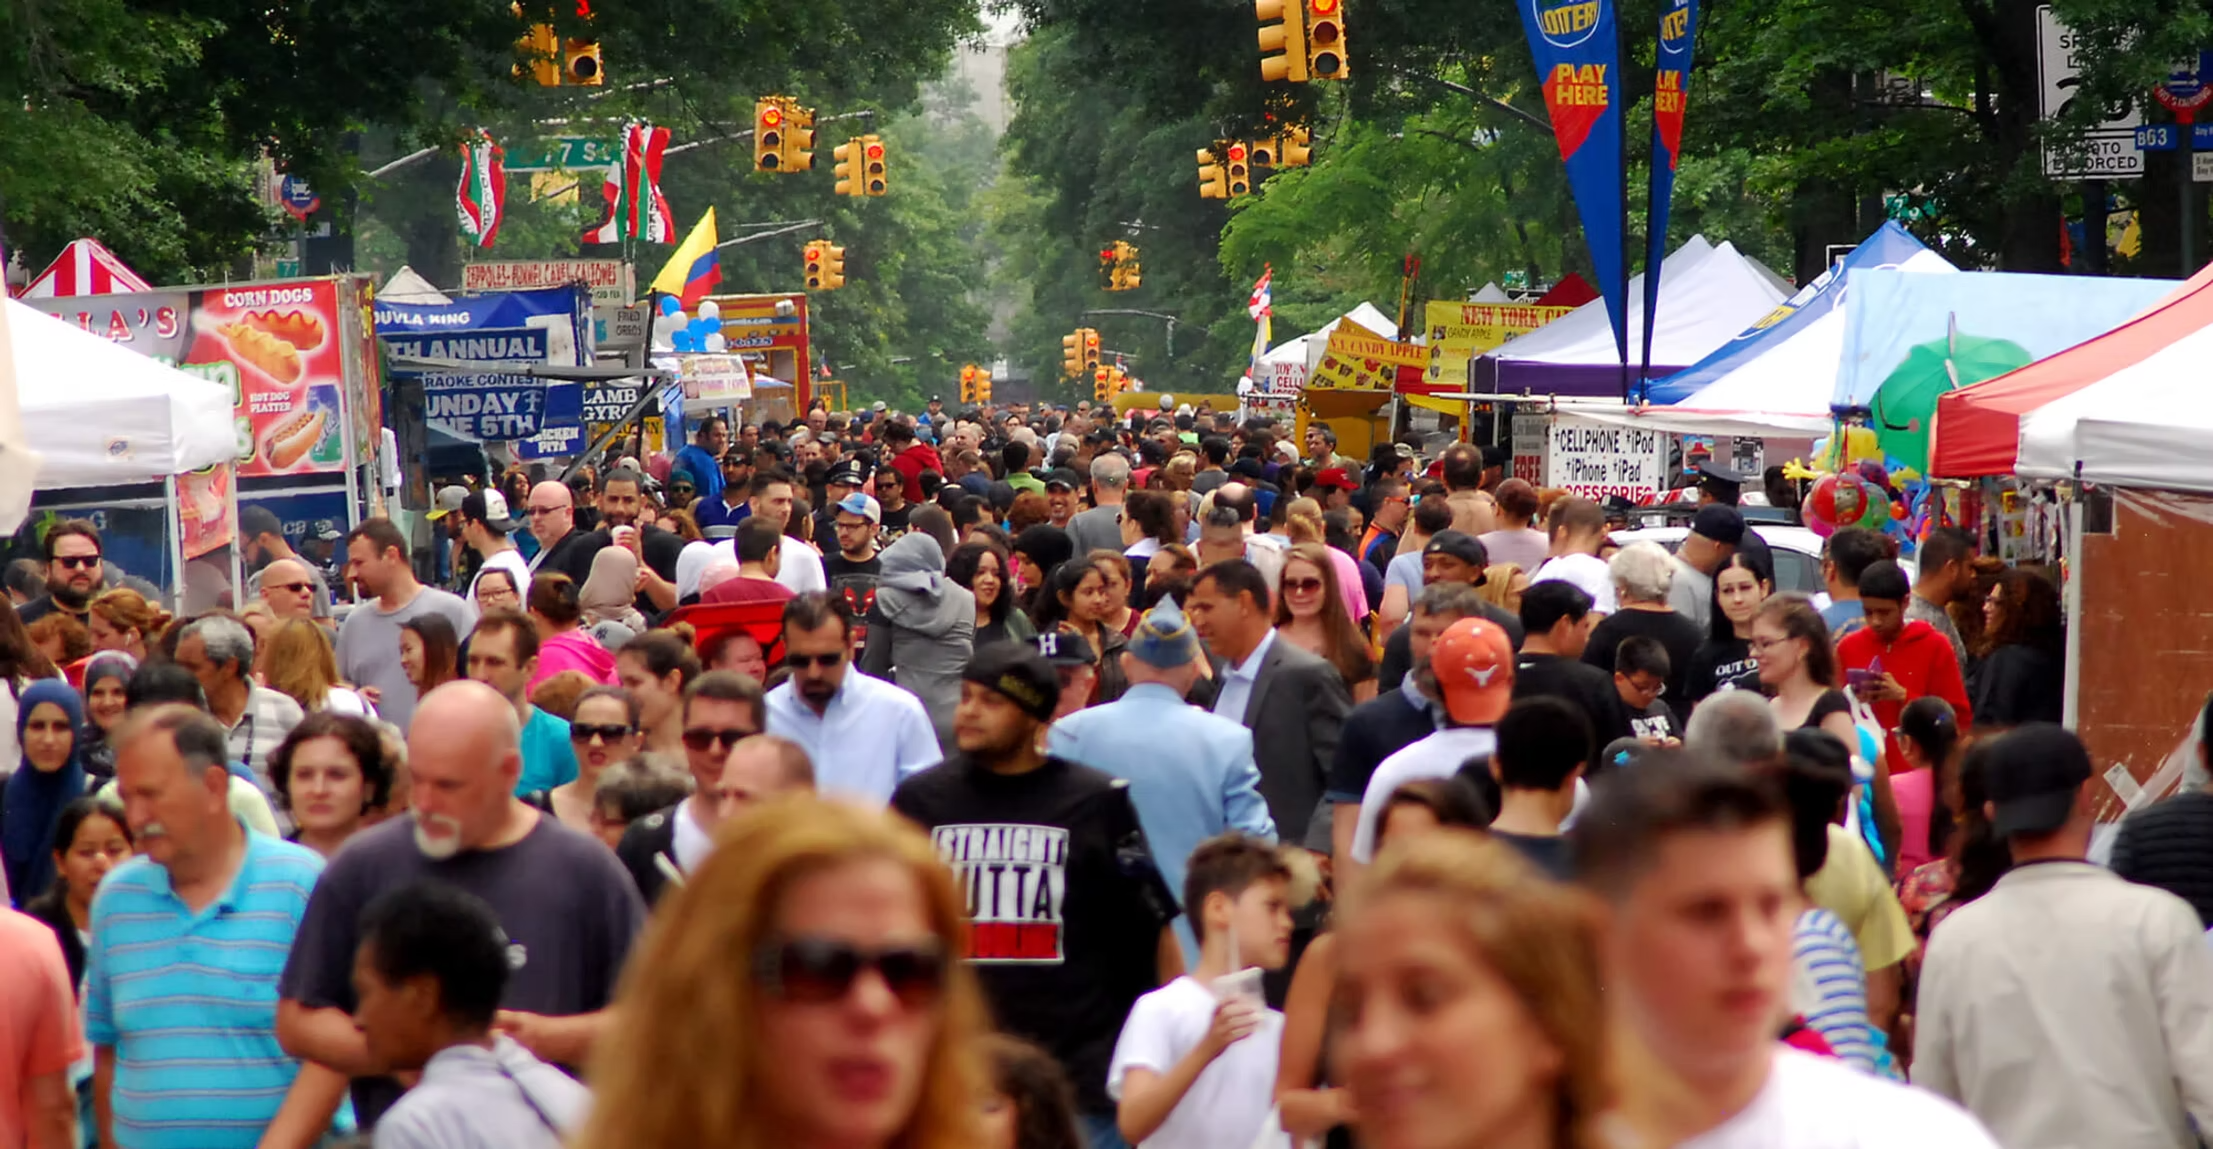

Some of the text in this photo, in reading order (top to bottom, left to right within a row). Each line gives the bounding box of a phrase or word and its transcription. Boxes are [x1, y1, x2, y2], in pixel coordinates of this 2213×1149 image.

[1556, 63, 1607, 84] PLAY
[1556, 85, 1609, 105] HERE
[2137, 128, 2167, 146] B63
[224, 288, 313, 309] CORN DOGS
[428, 311, 470, 324] KING
[1461, 305, 1494, 326] NEW
[1500, 306, 1539, 328] YORK
[429, 336, 543, 360] ANNUAL
[1390, 344, 1423, 359] APPLE
[425, 391, 520, 417] UNDAY
[582, 388, 638, 404] LAMB
[250, 402, 291, 413] PLATTER
[481, 414, 536, 437] 5TH
[538, 440, 568, 453] PITA
[1039, 633, 1057, 655] H
[1714, 659, 1743, 676] OUT
[936, 826, 1064, 864] STRAIGHT
[960, 865, 1054, 919] UTTA
